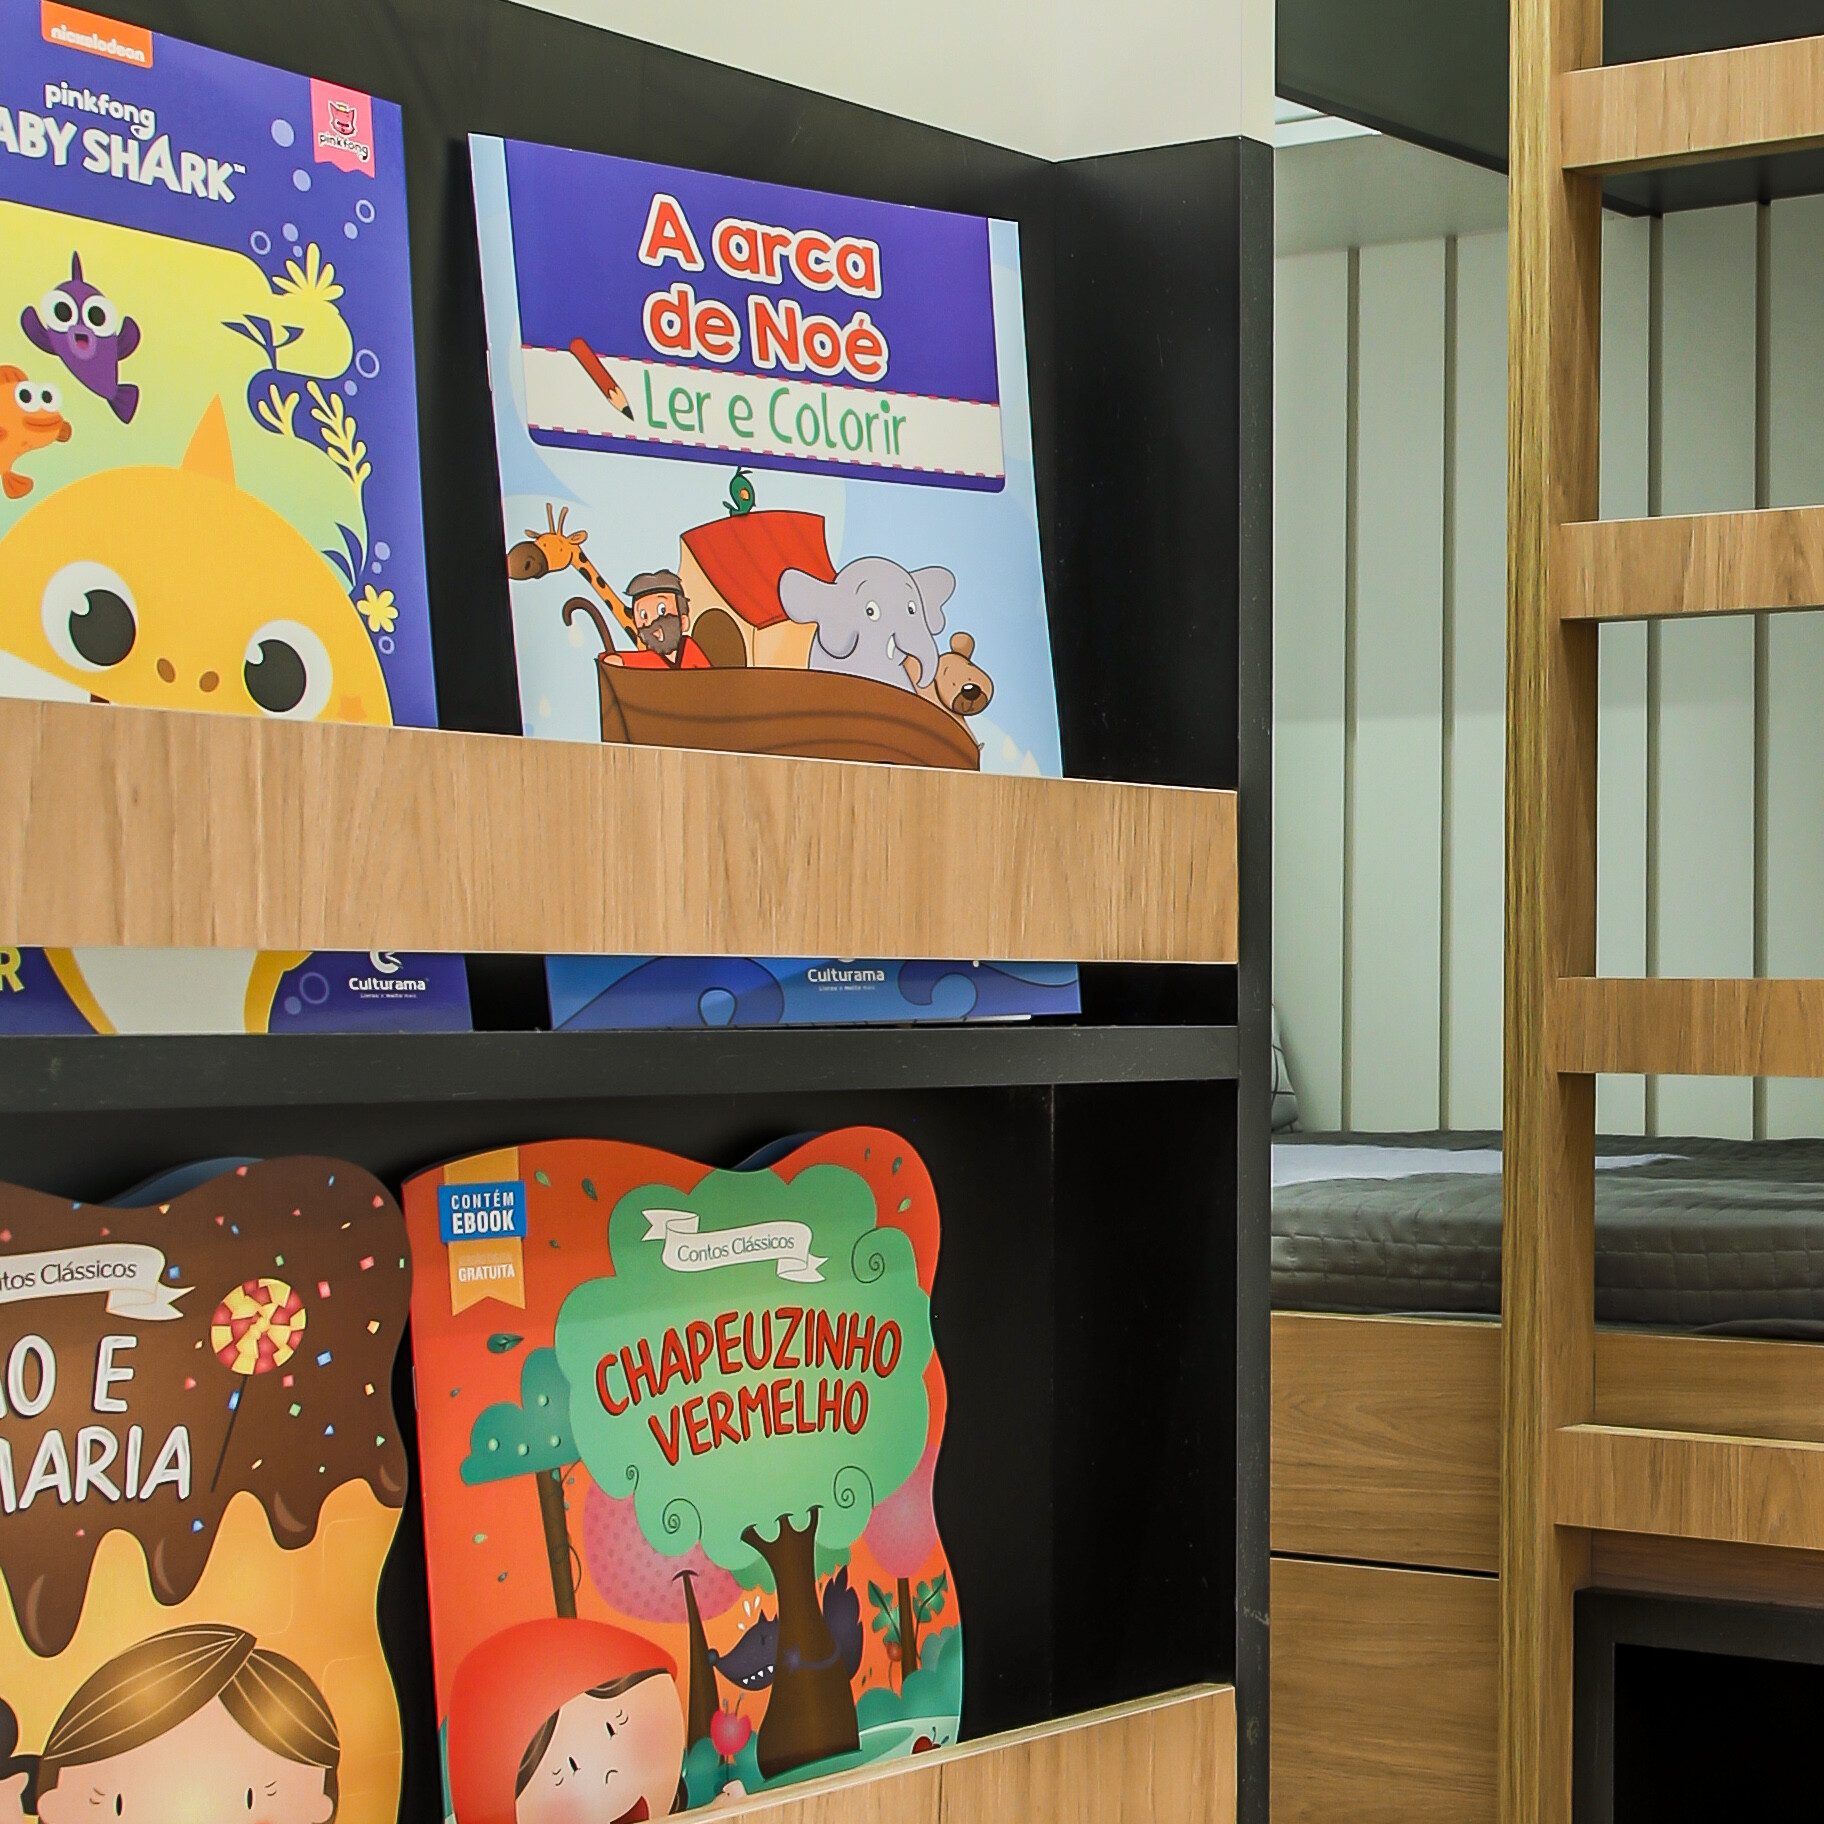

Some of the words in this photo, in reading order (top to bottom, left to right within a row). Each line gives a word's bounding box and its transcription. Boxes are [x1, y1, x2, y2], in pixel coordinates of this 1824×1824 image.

[44, 80, 156, 141] pinkfong
[318, 131, 370, 162] pinkfong
[640, 194, 703, 270] A
[713, 220, 880, 297] arca
[645, 284, 740, 362] de
[749, 296, 887, 380] Noé
[644, 369, 711, 433] Ler
[728, 394, 754, 438] e
[769, 387, 906, 456] Colorir
[348, 977, 427, 991] Culturama
[807, 968, 886, 983] Culturama
[451, 1189, 514, 1210] CONTÉM
[452, 1209, 515, 1235] EBOOK
[677, 1244, 729, 1263] Contos
[731, 1235, 795, 1254] Clássicos
[40, 1259, 137, 1284] Clássicos
[458, 1263, 516, 1282] GRATUITA
[93, 1334, 138, 1413] E
[596, 1306, 902, 1416] CHAPEUZINHO
[648, 1377, 869, 1466] VERMELHO
